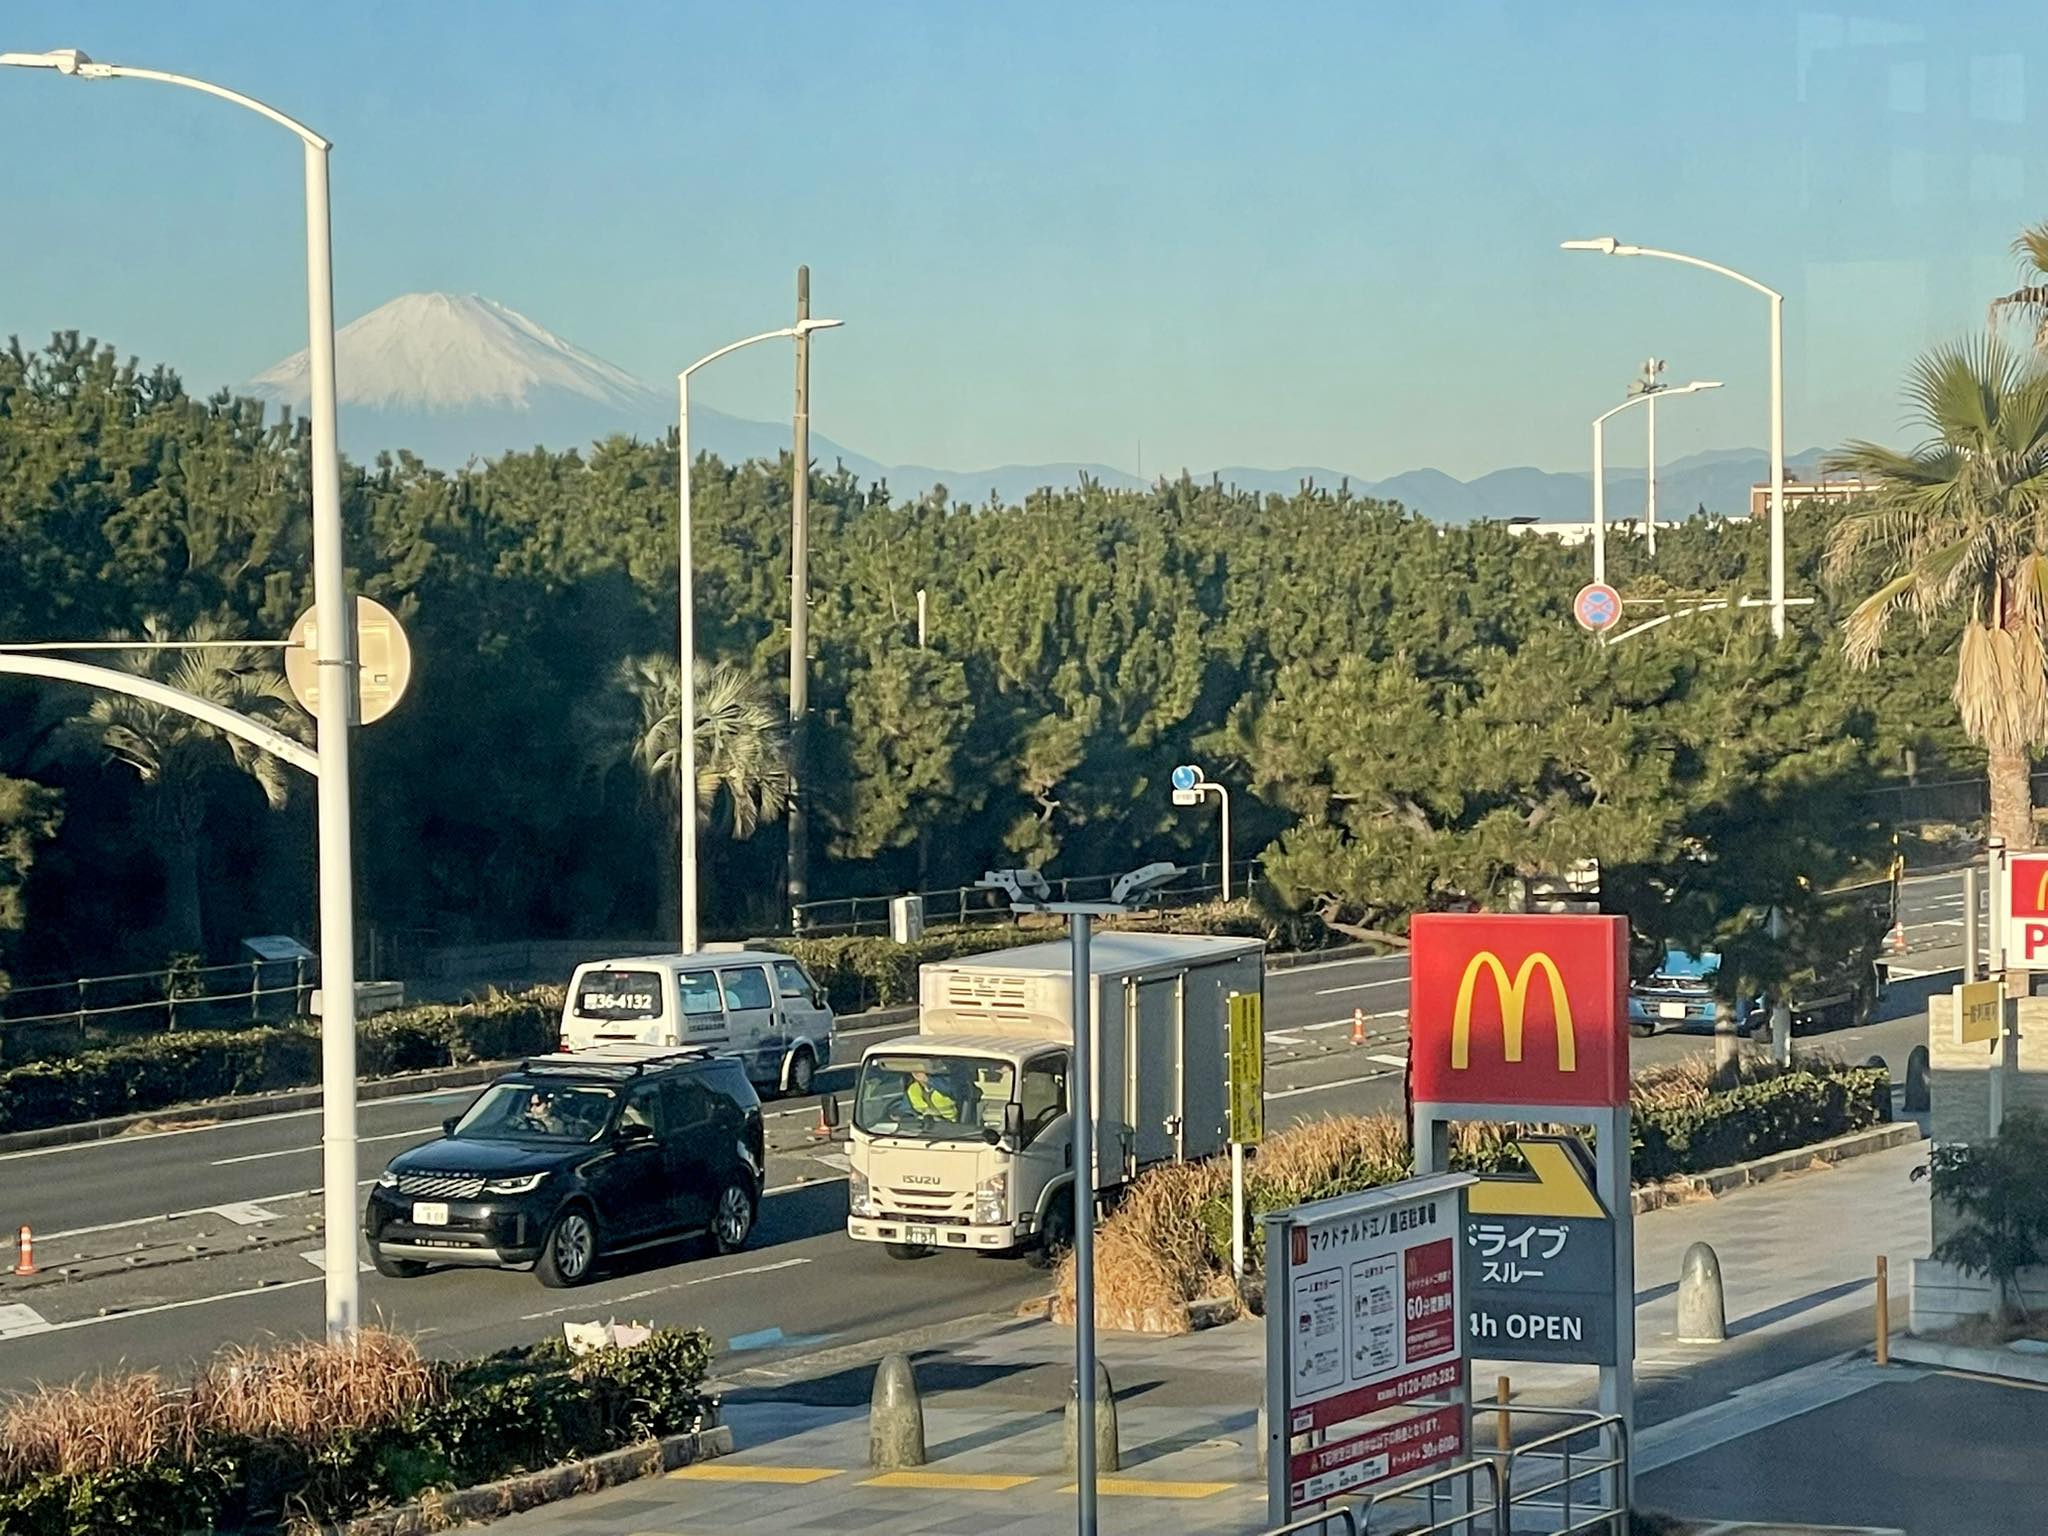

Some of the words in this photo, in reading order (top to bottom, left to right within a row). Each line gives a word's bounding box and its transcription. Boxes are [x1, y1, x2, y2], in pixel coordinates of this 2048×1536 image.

[902, 1173, 941, 1186] ISUZU
[1482, 1261, 1544, 1284] スルー
[1506, 1314, 1582, 1341] OPEN
